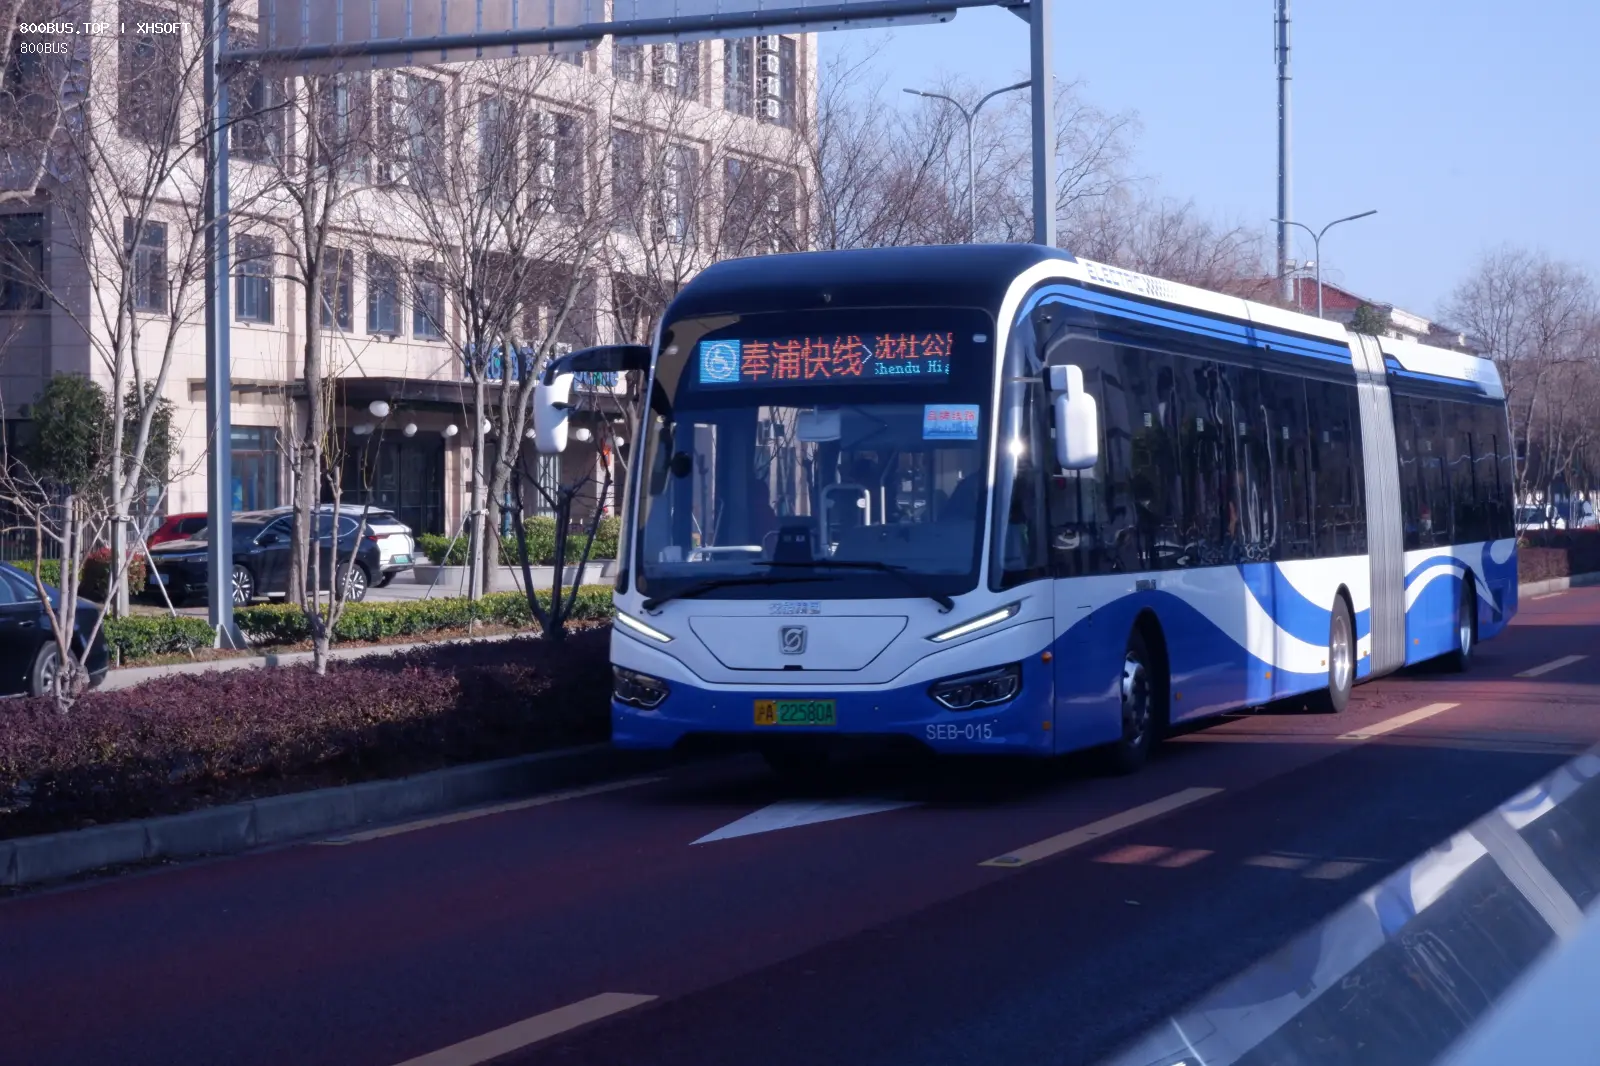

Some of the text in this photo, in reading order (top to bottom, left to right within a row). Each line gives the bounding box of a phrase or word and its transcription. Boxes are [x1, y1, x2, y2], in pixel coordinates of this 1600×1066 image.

[740, 335, 864, 380] 奉浦快线
[926, 724, 992, 740] SEB-015
